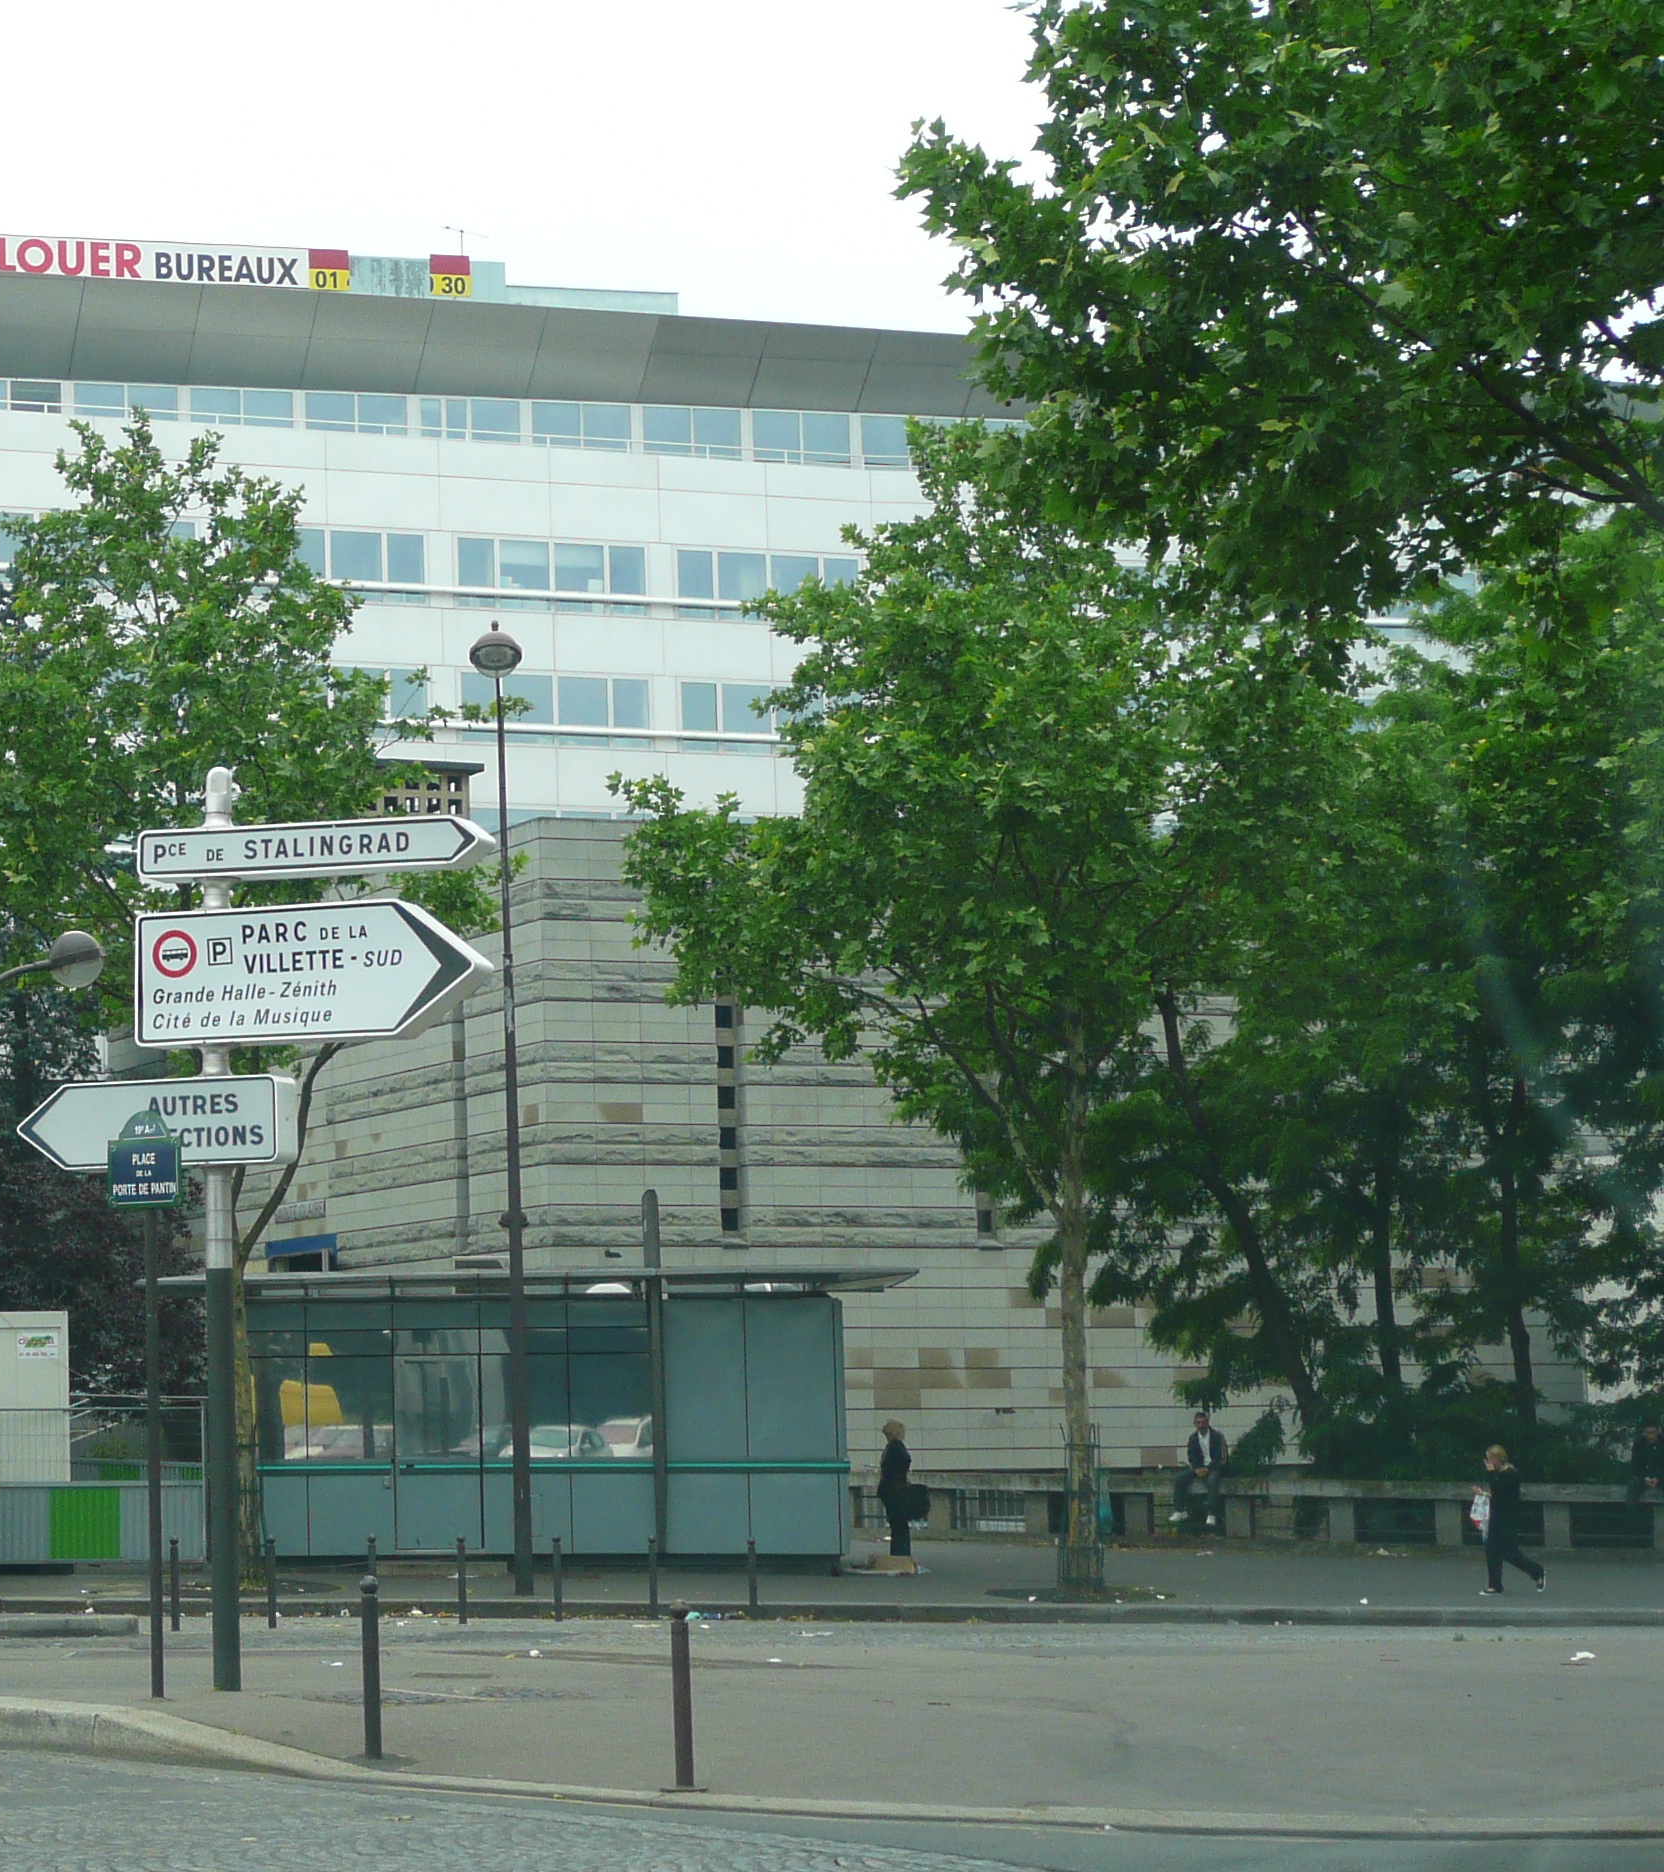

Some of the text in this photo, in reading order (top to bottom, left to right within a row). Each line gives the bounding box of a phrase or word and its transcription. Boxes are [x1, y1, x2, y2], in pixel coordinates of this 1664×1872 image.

[154, 252, 299, 286] BUREAUX
[315, 270, 466, 295] 01 30
[206, 848, 224, 862] DE
[243, 831, 410, 860] STALINGRAD
[241, 921, 368, 945] PARC DE LA
[212, 942, 227, 962] P
[243, 949, 344, 974] VILLETTE
[363, 949, 403, 967] SUD
[153, 986, 215, 1005] Grande
[152, 1007, 333, 1030] Cité de la Musique
[148, 1093, 239, 1116] AUTRES
[132, 1153, 156, 1166] PLACE
[113, 1182, 177, 1196] PORTE DE PANTIN
